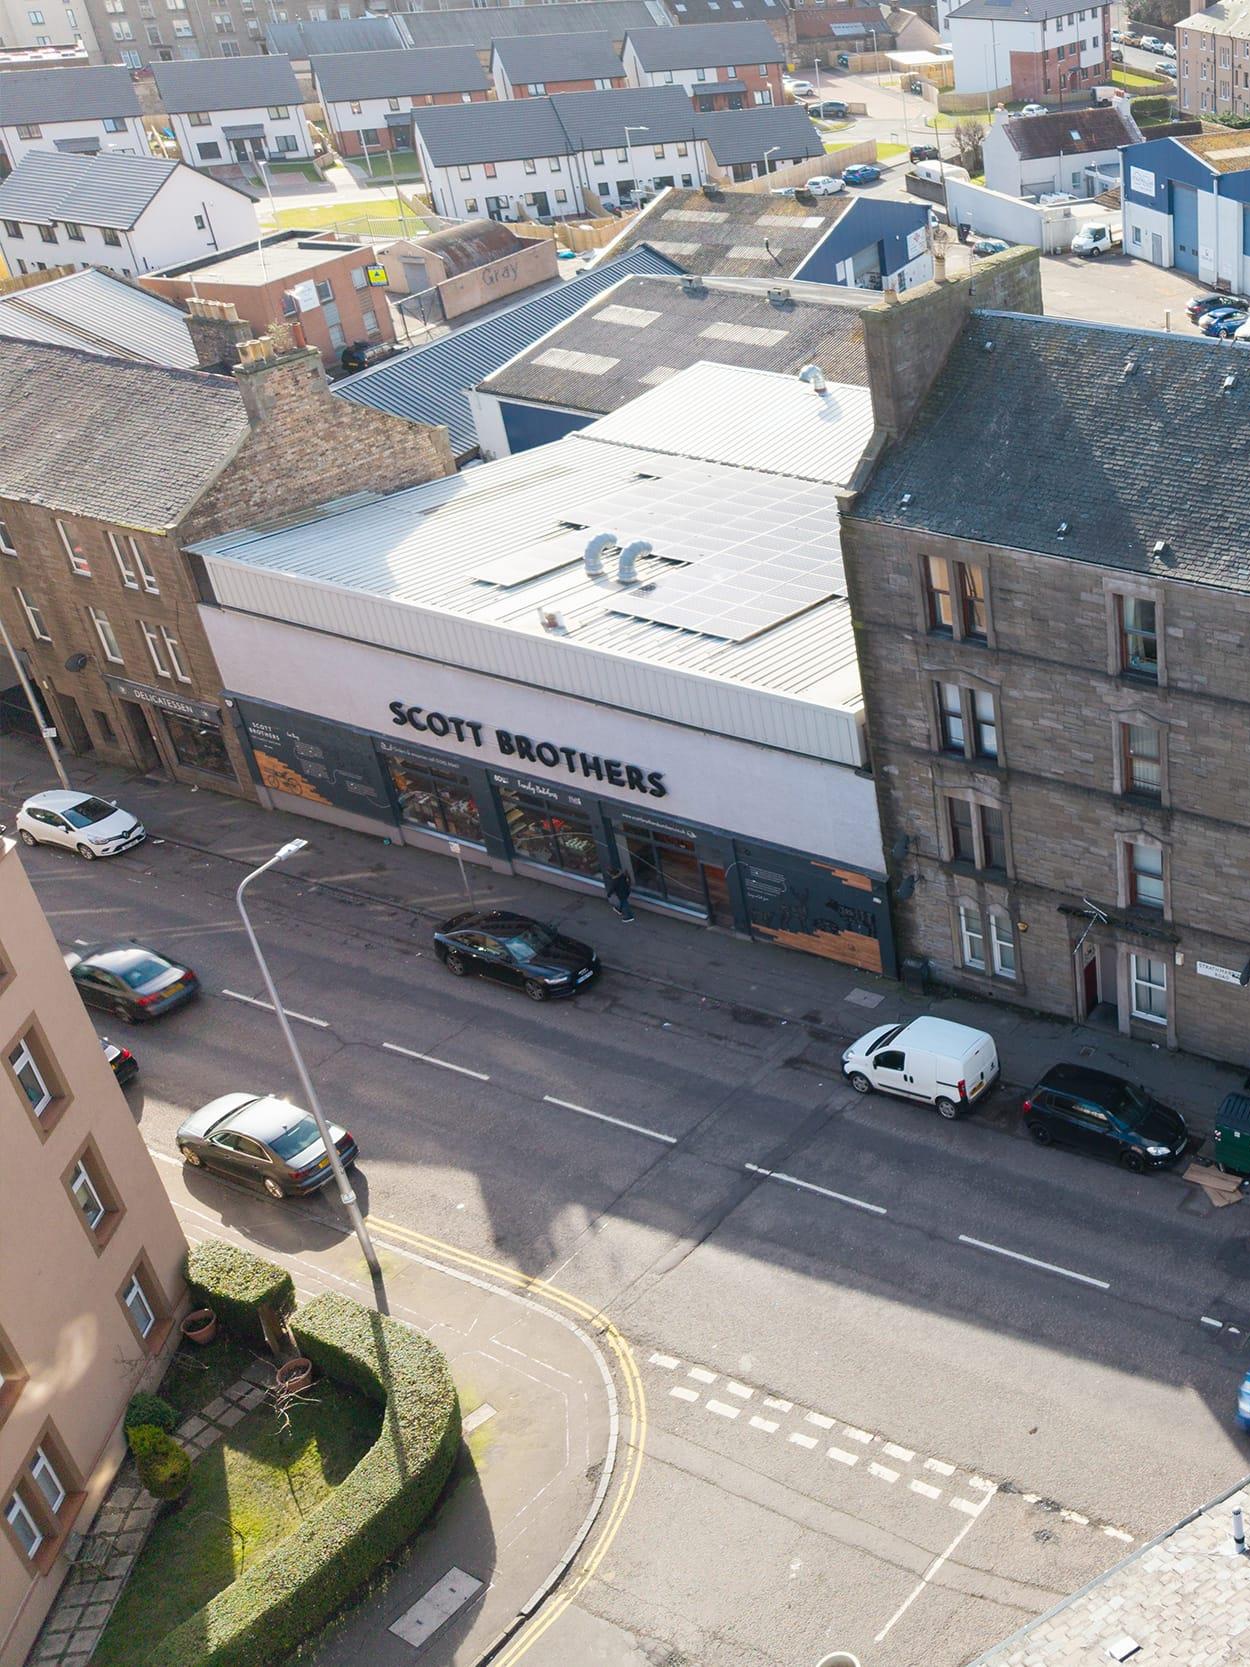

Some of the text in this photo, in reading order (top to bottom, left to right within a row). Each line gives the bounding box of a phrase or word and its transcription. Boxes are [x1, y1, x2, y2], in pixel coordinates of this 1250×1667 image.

[482, 262, 518, 286] Gray
[133, 689, 194, 713] DELICATESSEN
[389, 701, 668, 798] SCOTT BROTHERS
